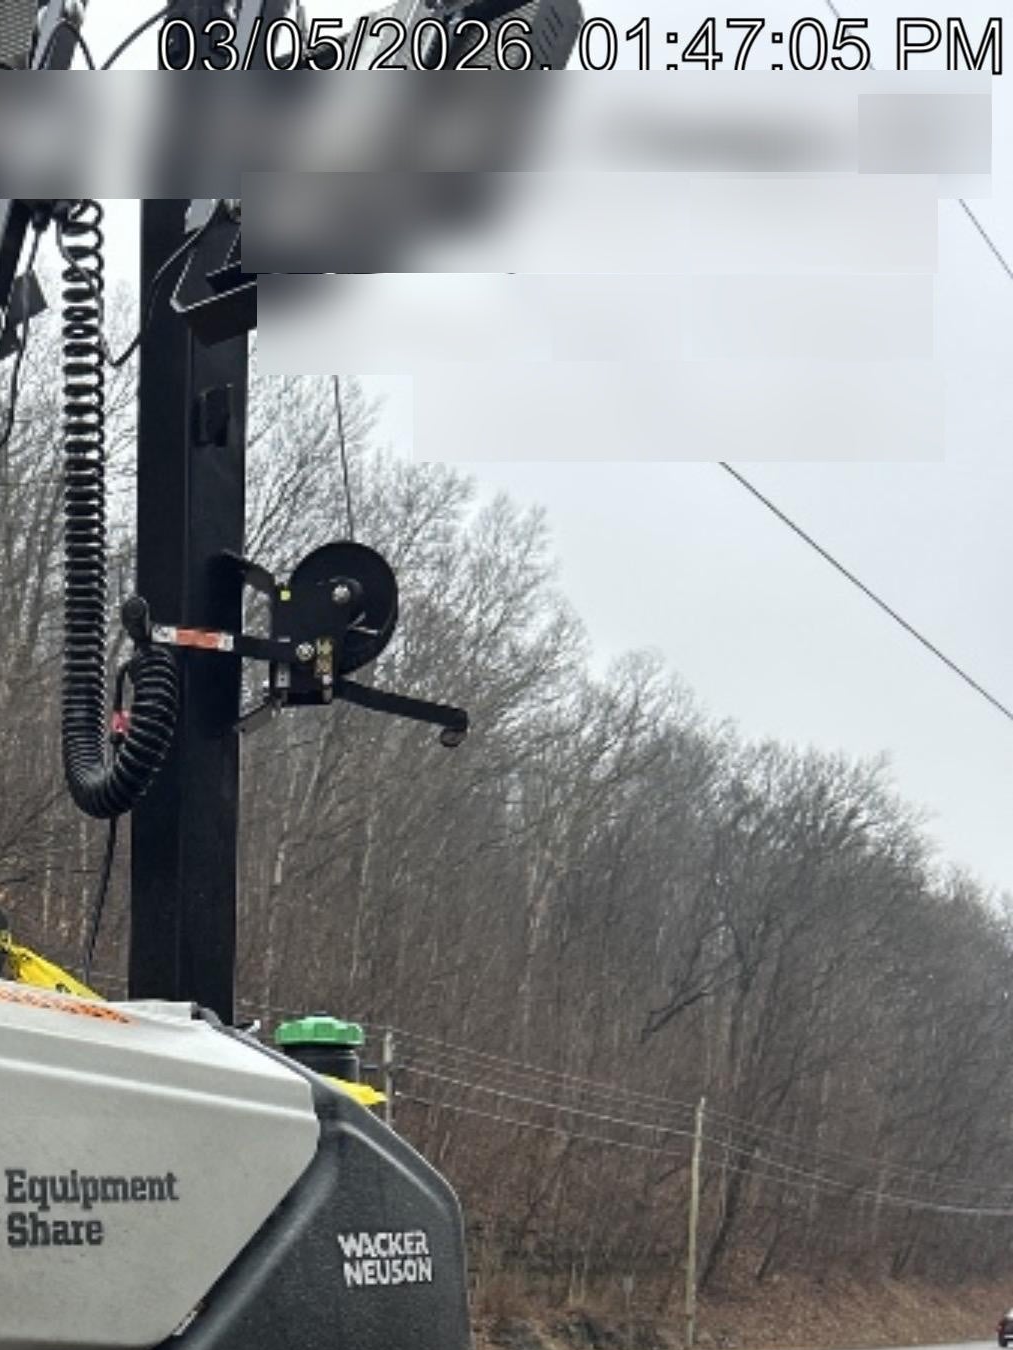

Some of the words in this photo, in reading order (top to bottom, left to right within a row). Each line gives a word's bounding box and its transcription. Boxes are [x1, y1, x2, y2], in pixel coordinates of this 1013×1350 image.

[4, 1169, 180, 1212] Equipment
[7, 1211, 104, 1247] Share
[337, 1230, 430, 1258] WACKER
[343, 1256, 432, 1288] NEUSON
